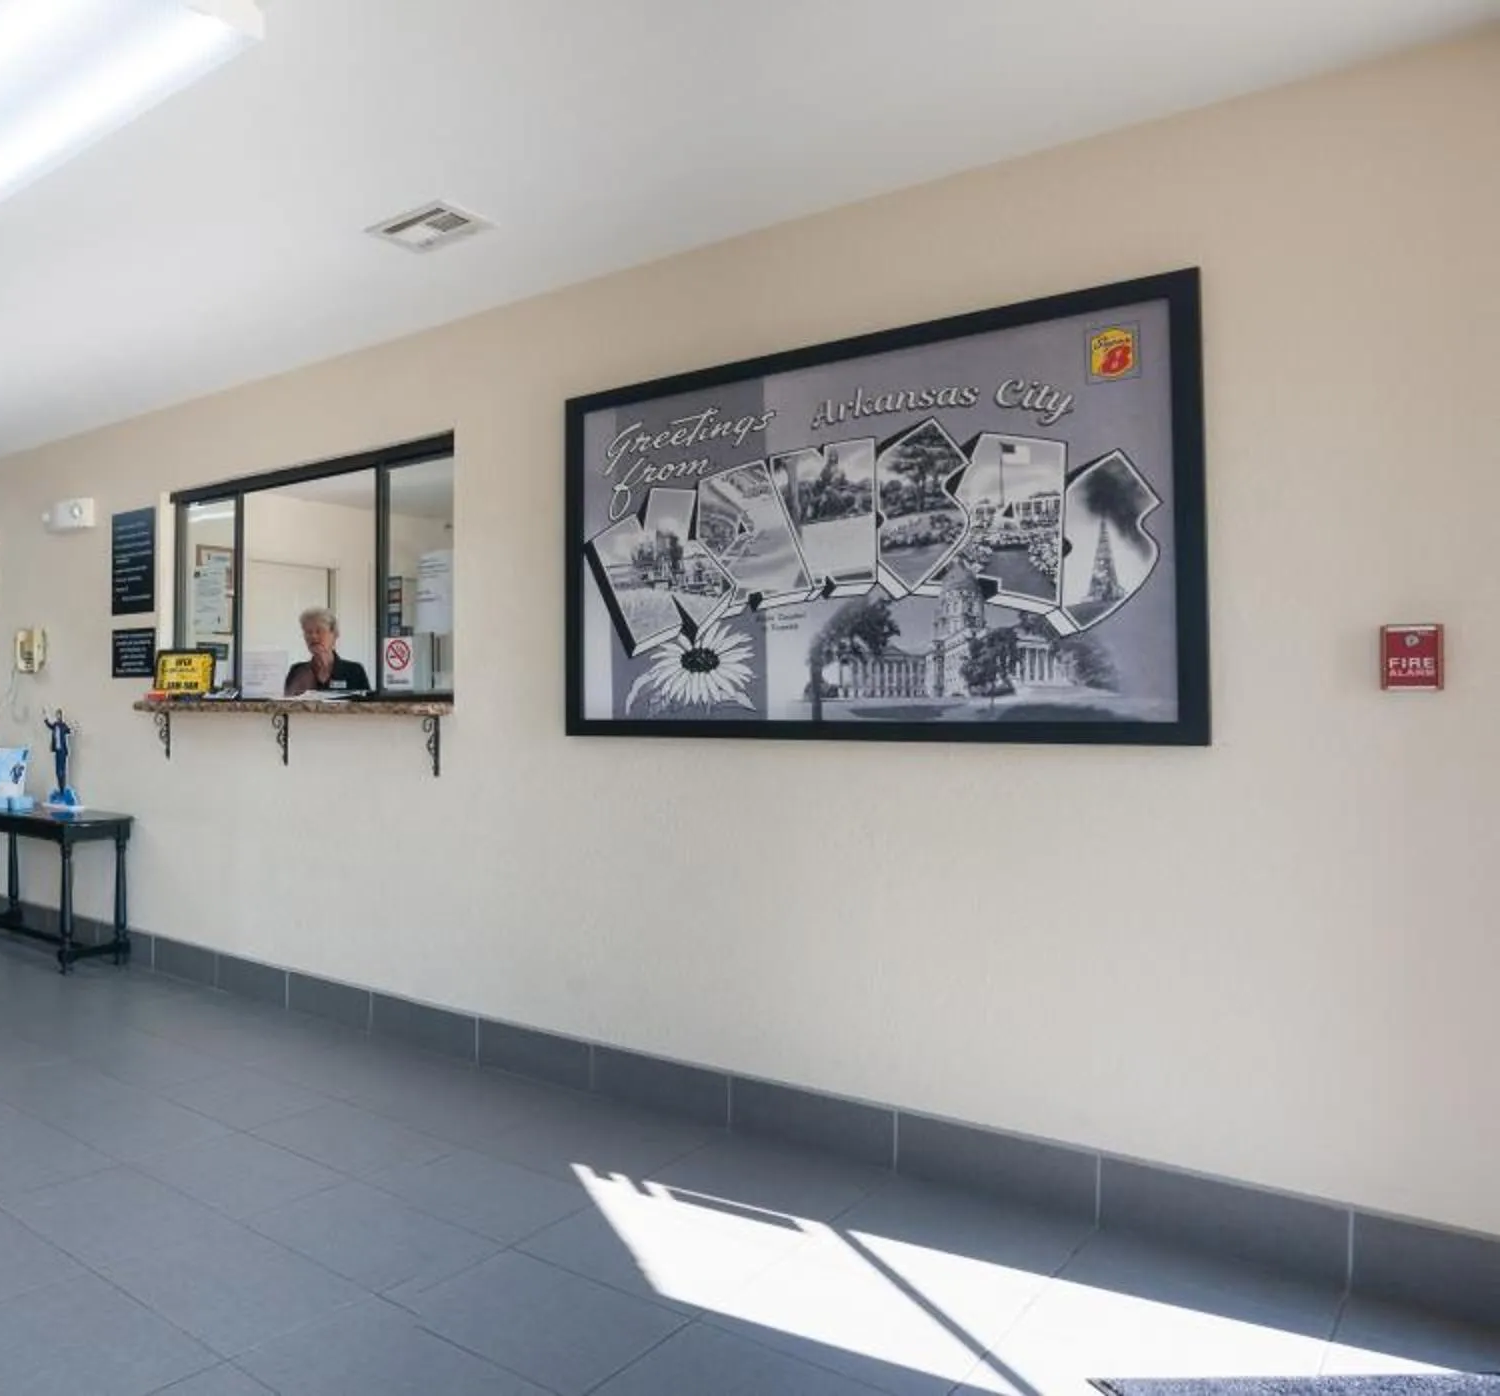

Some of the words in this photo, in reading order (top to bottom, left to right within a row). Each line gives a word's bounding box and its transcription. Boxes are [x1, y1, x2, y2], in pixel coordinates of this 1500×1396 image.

[1101, 346, 1133, 376] 8
[810, 384, 980, 431] Arkansas
[994, 378, 1075, 427] City
[604, 405, 777, 475] Greetings
[609, 457, 710, 521] from
[583, 415, 1164, 657] KANSAS
[1389, 657, 1435, 669] FIRE
[1389, 669, 1435, 677] ALARM
